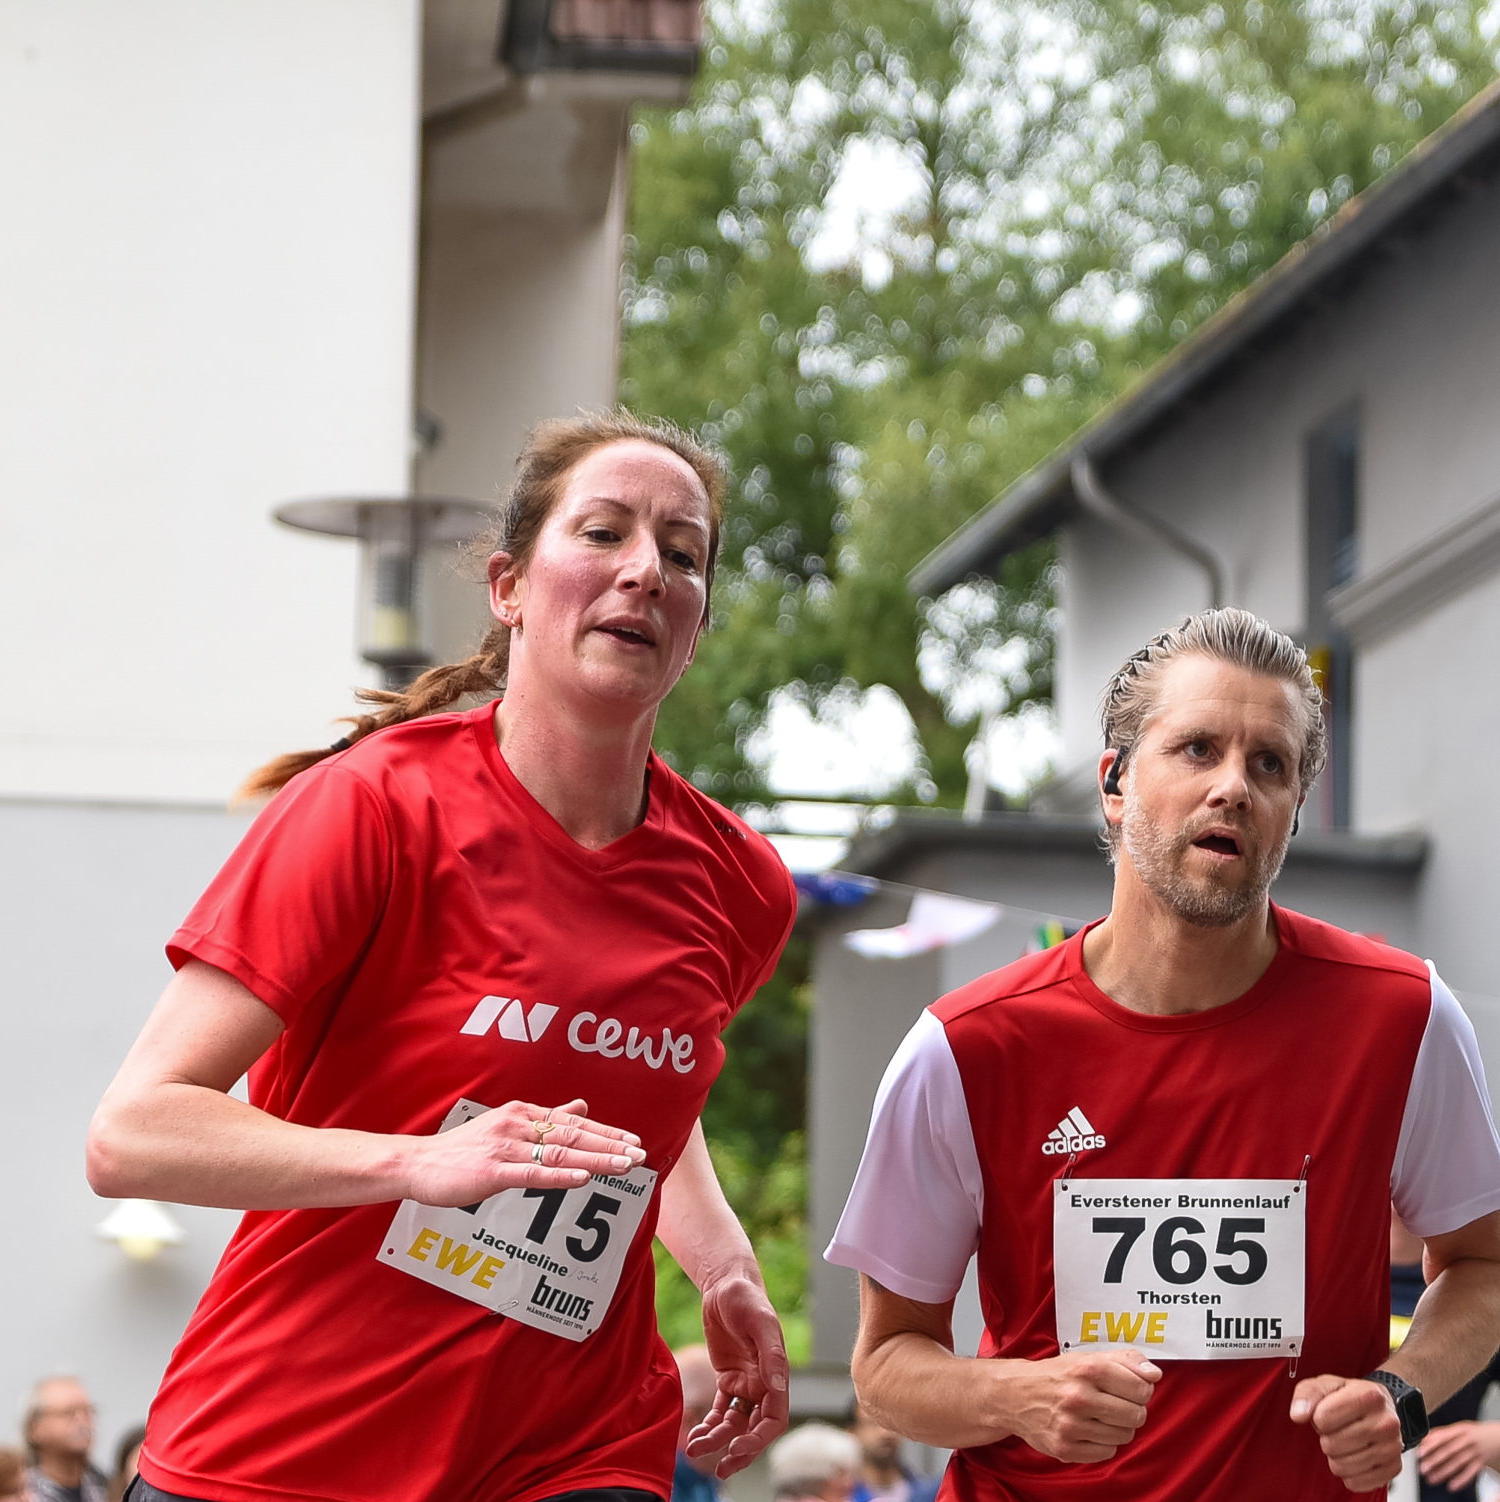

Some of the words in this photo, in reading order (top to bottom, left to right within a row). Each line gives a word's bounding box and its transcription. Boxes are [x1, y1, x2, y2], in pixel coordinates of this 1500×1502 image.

[567, 1011, 696, 1074] cewe
[1041, 1134, 1106, 1155] adidas
[1070, 1194, 1171, 1209] Everstener
[1177, 1195, 1290, 1209] Brunnenlauf
[455, 1188, 622, 1263] 15
[406, 1228, 506, 1290] EWE
[471, 1228, 569, 1277] Jacqueline
[1092, 1216, 1268, 1286] 765
[530, 1274, 594, 1321] bruns
[1137, 1290, 1221, 1305] Thorsten
[1079, 1312, 1168, 1343] EWE
[1206, 1309, 1282, 1339] bruns
